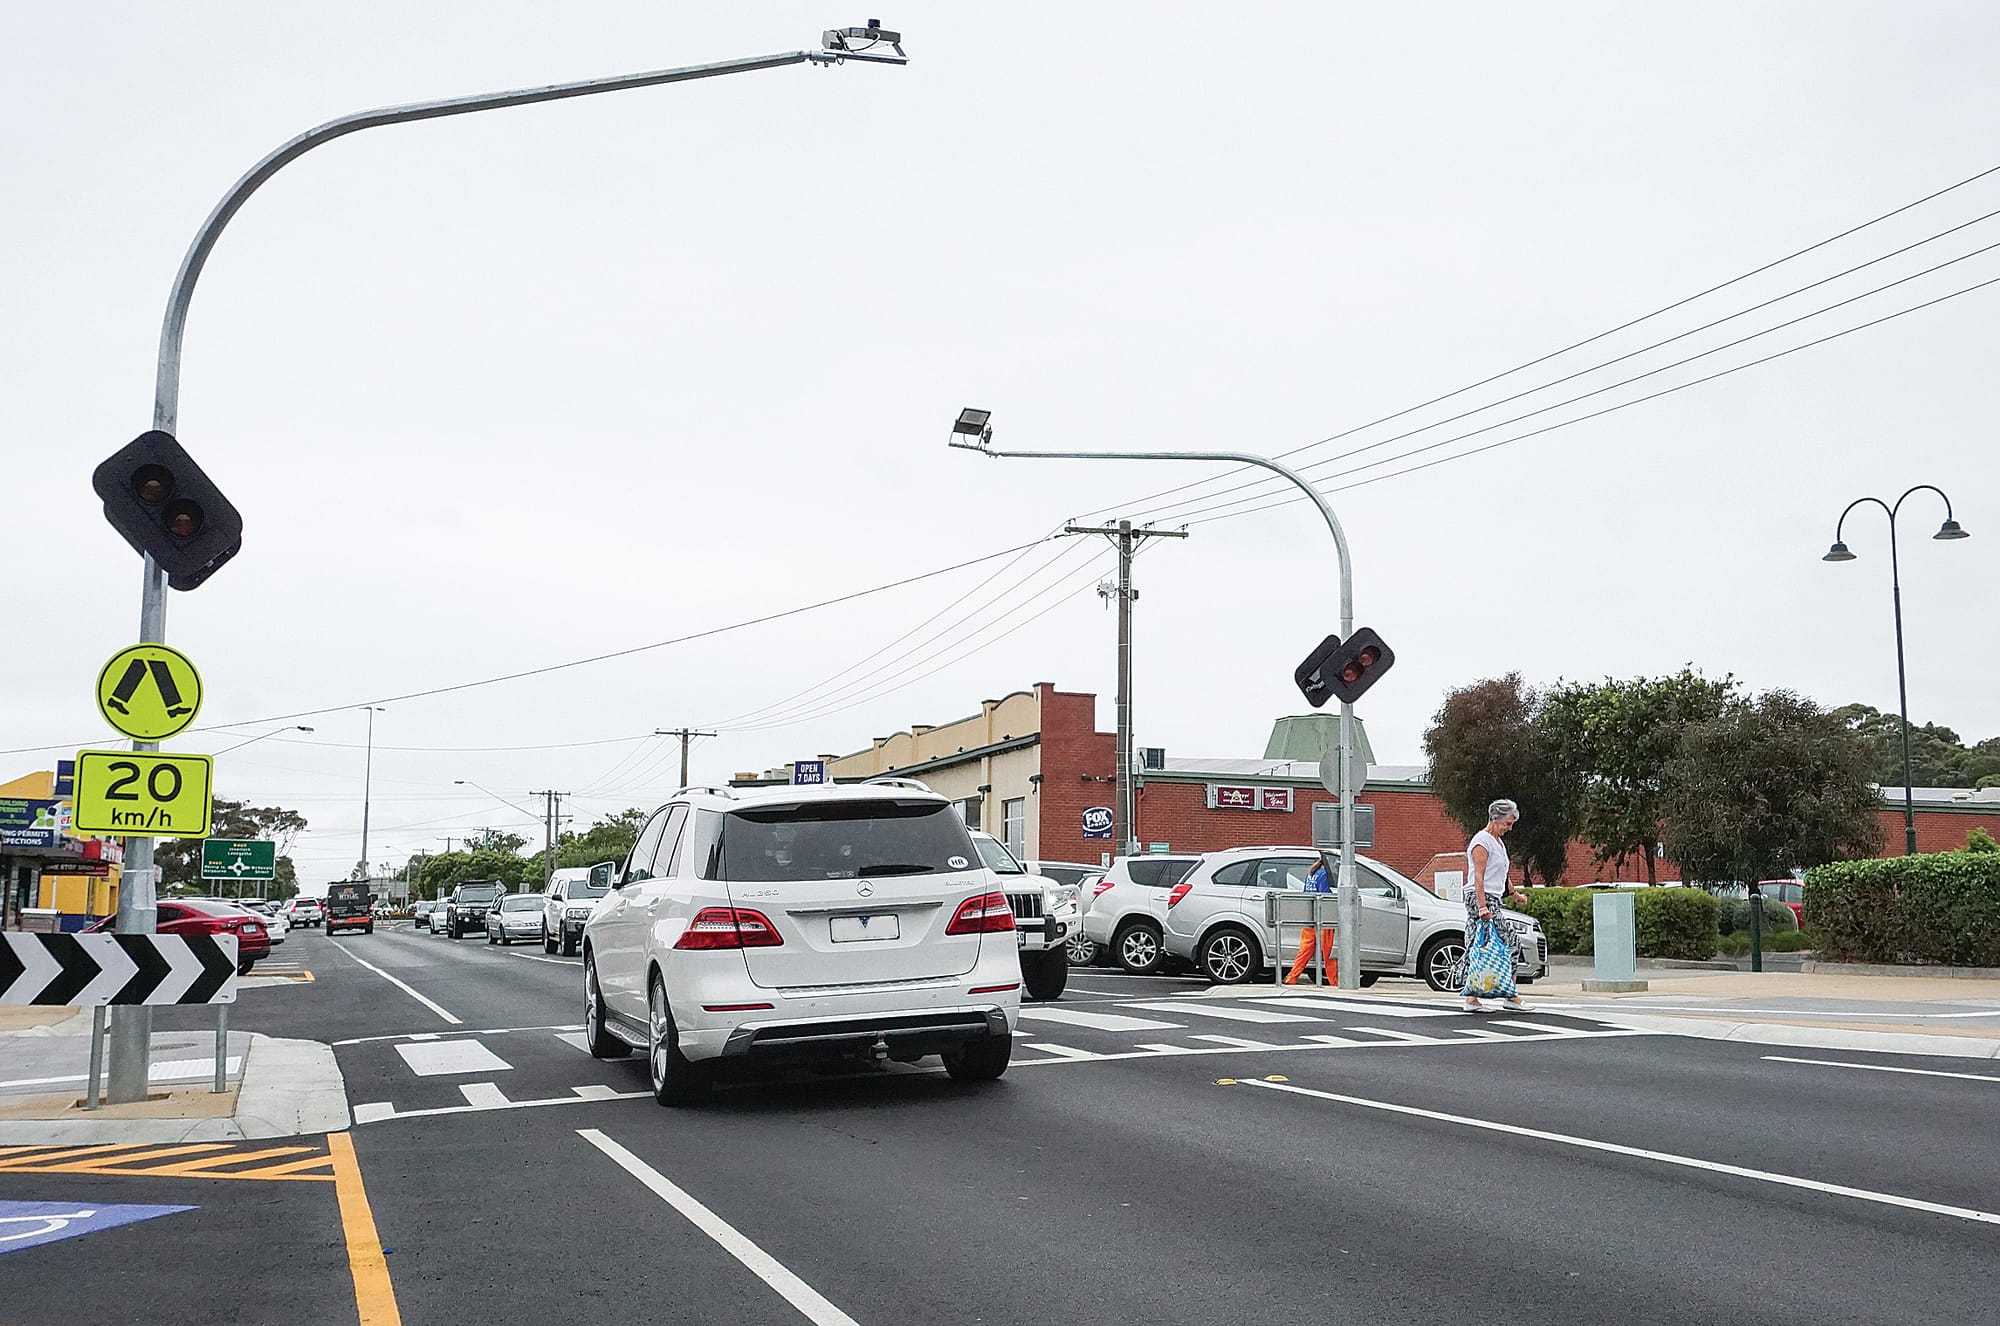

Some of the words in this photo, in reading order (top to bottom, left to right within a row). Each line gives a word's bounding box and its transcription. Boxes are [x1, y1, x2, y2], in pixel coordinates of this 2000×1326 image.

[800, 763, 818, 773] OPEN
[105, 761, 182, 802] 20
[797, 773, 802, 782] 7
[803, 773, 821, 783] DAYS
[111, 806, 172, 828] km/h
[1085, 810, 1110, 825] FOX
[17, 830, 49, 838] PERMITS
